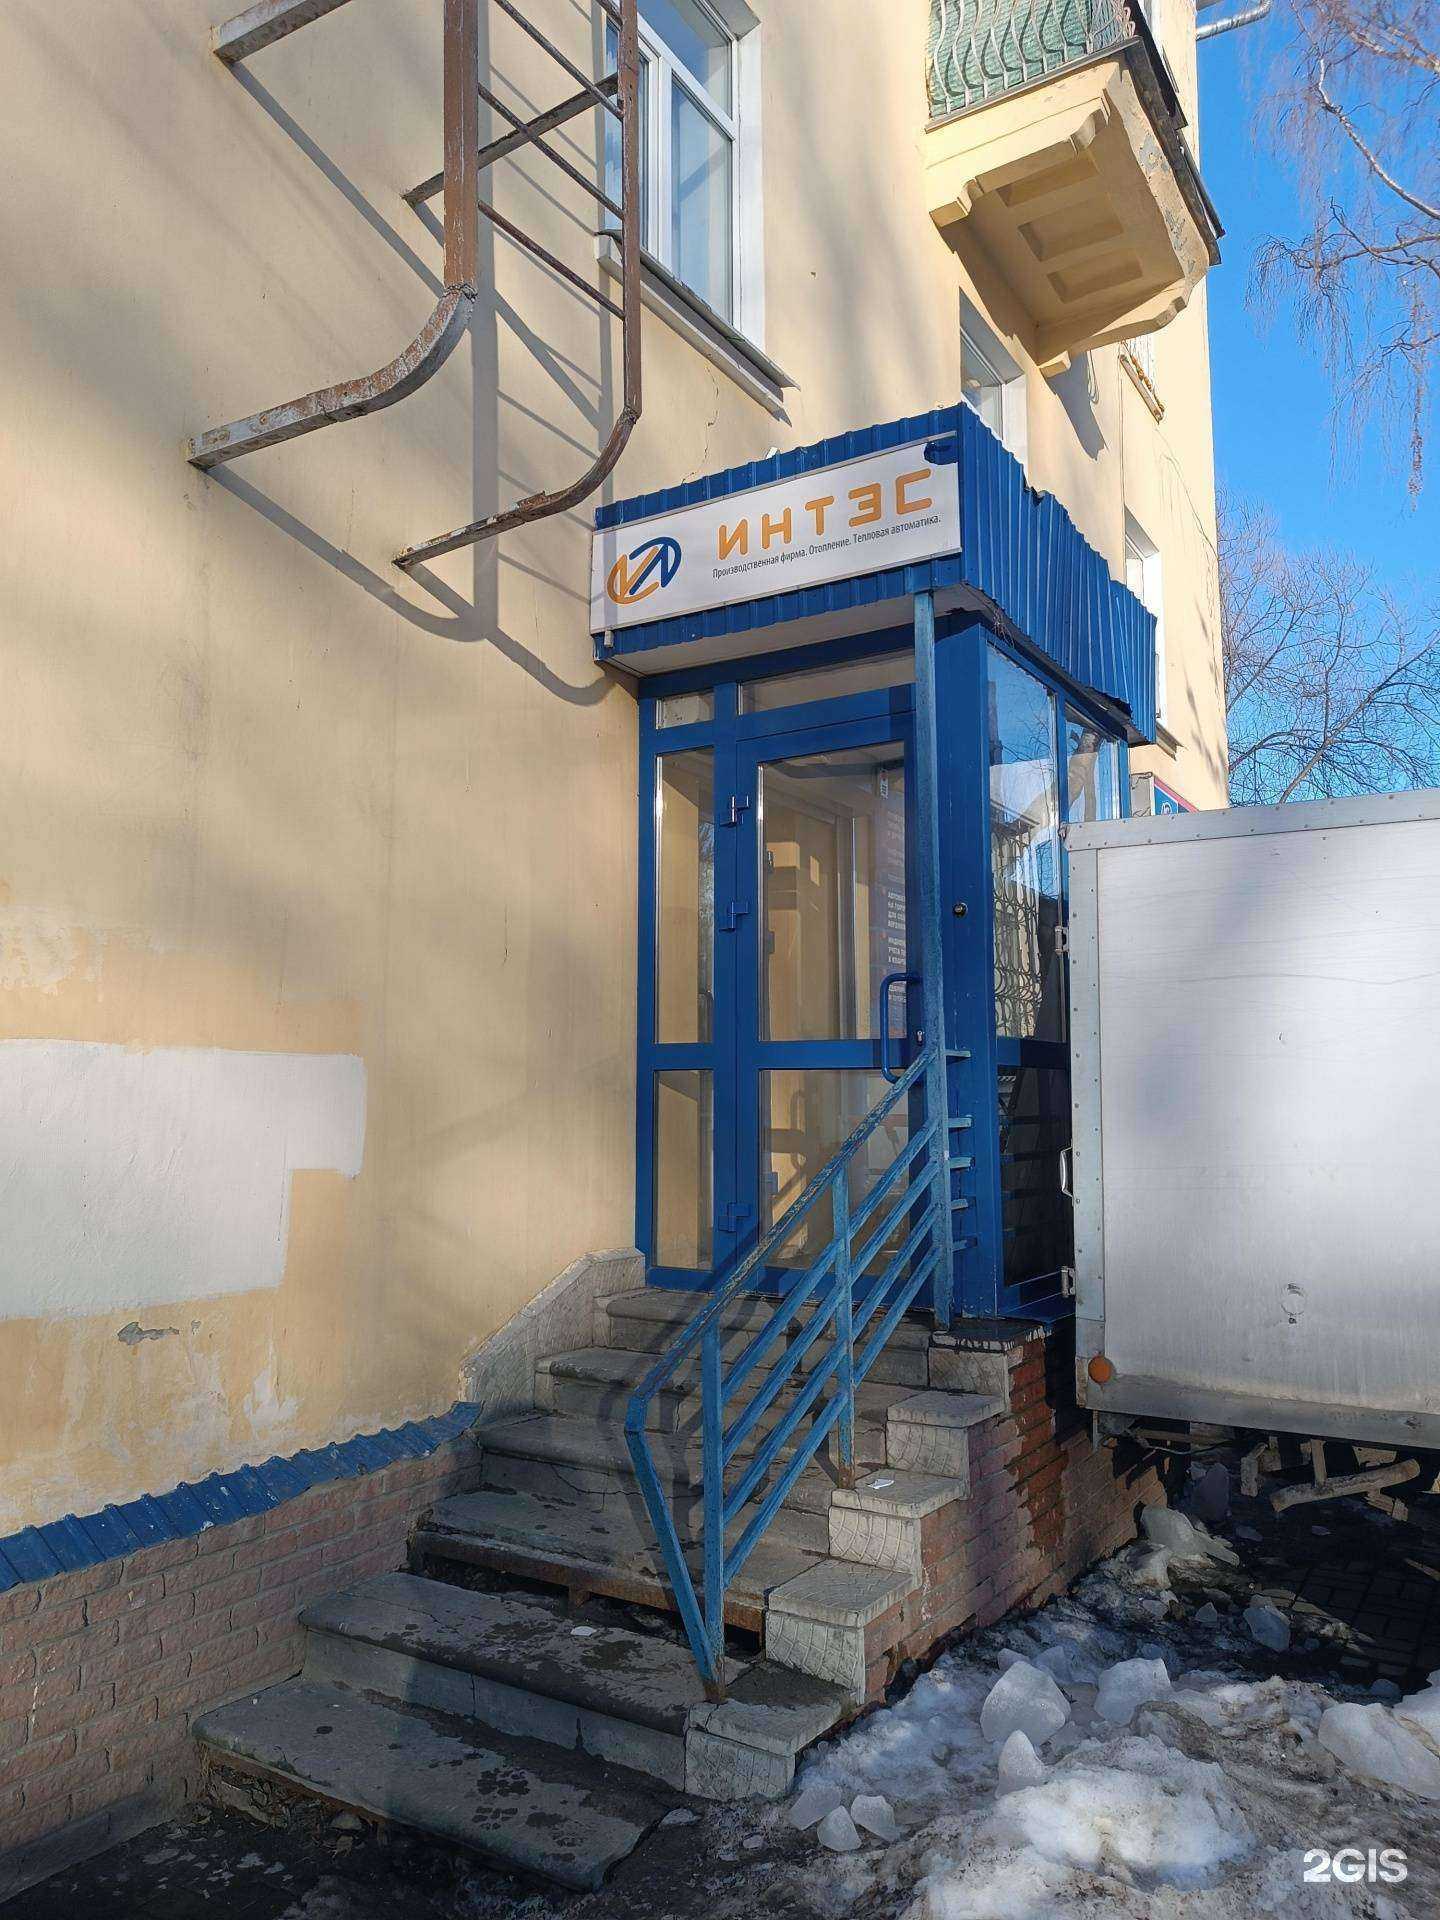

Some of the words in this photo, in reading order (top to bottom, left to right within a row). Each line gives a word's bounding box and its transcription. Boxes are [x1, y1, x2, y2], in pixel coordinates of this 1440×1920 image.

[712, 555, 780, 579] Производственная
[780, 550, 808, 563] фирма.
[808, 538, 852, 554] Отопление.
[853, 527, 890, 543] Тепловая
[890, 516, 942, 533] автоматика.
[718, 467, 932, 561] ИНТЭС
